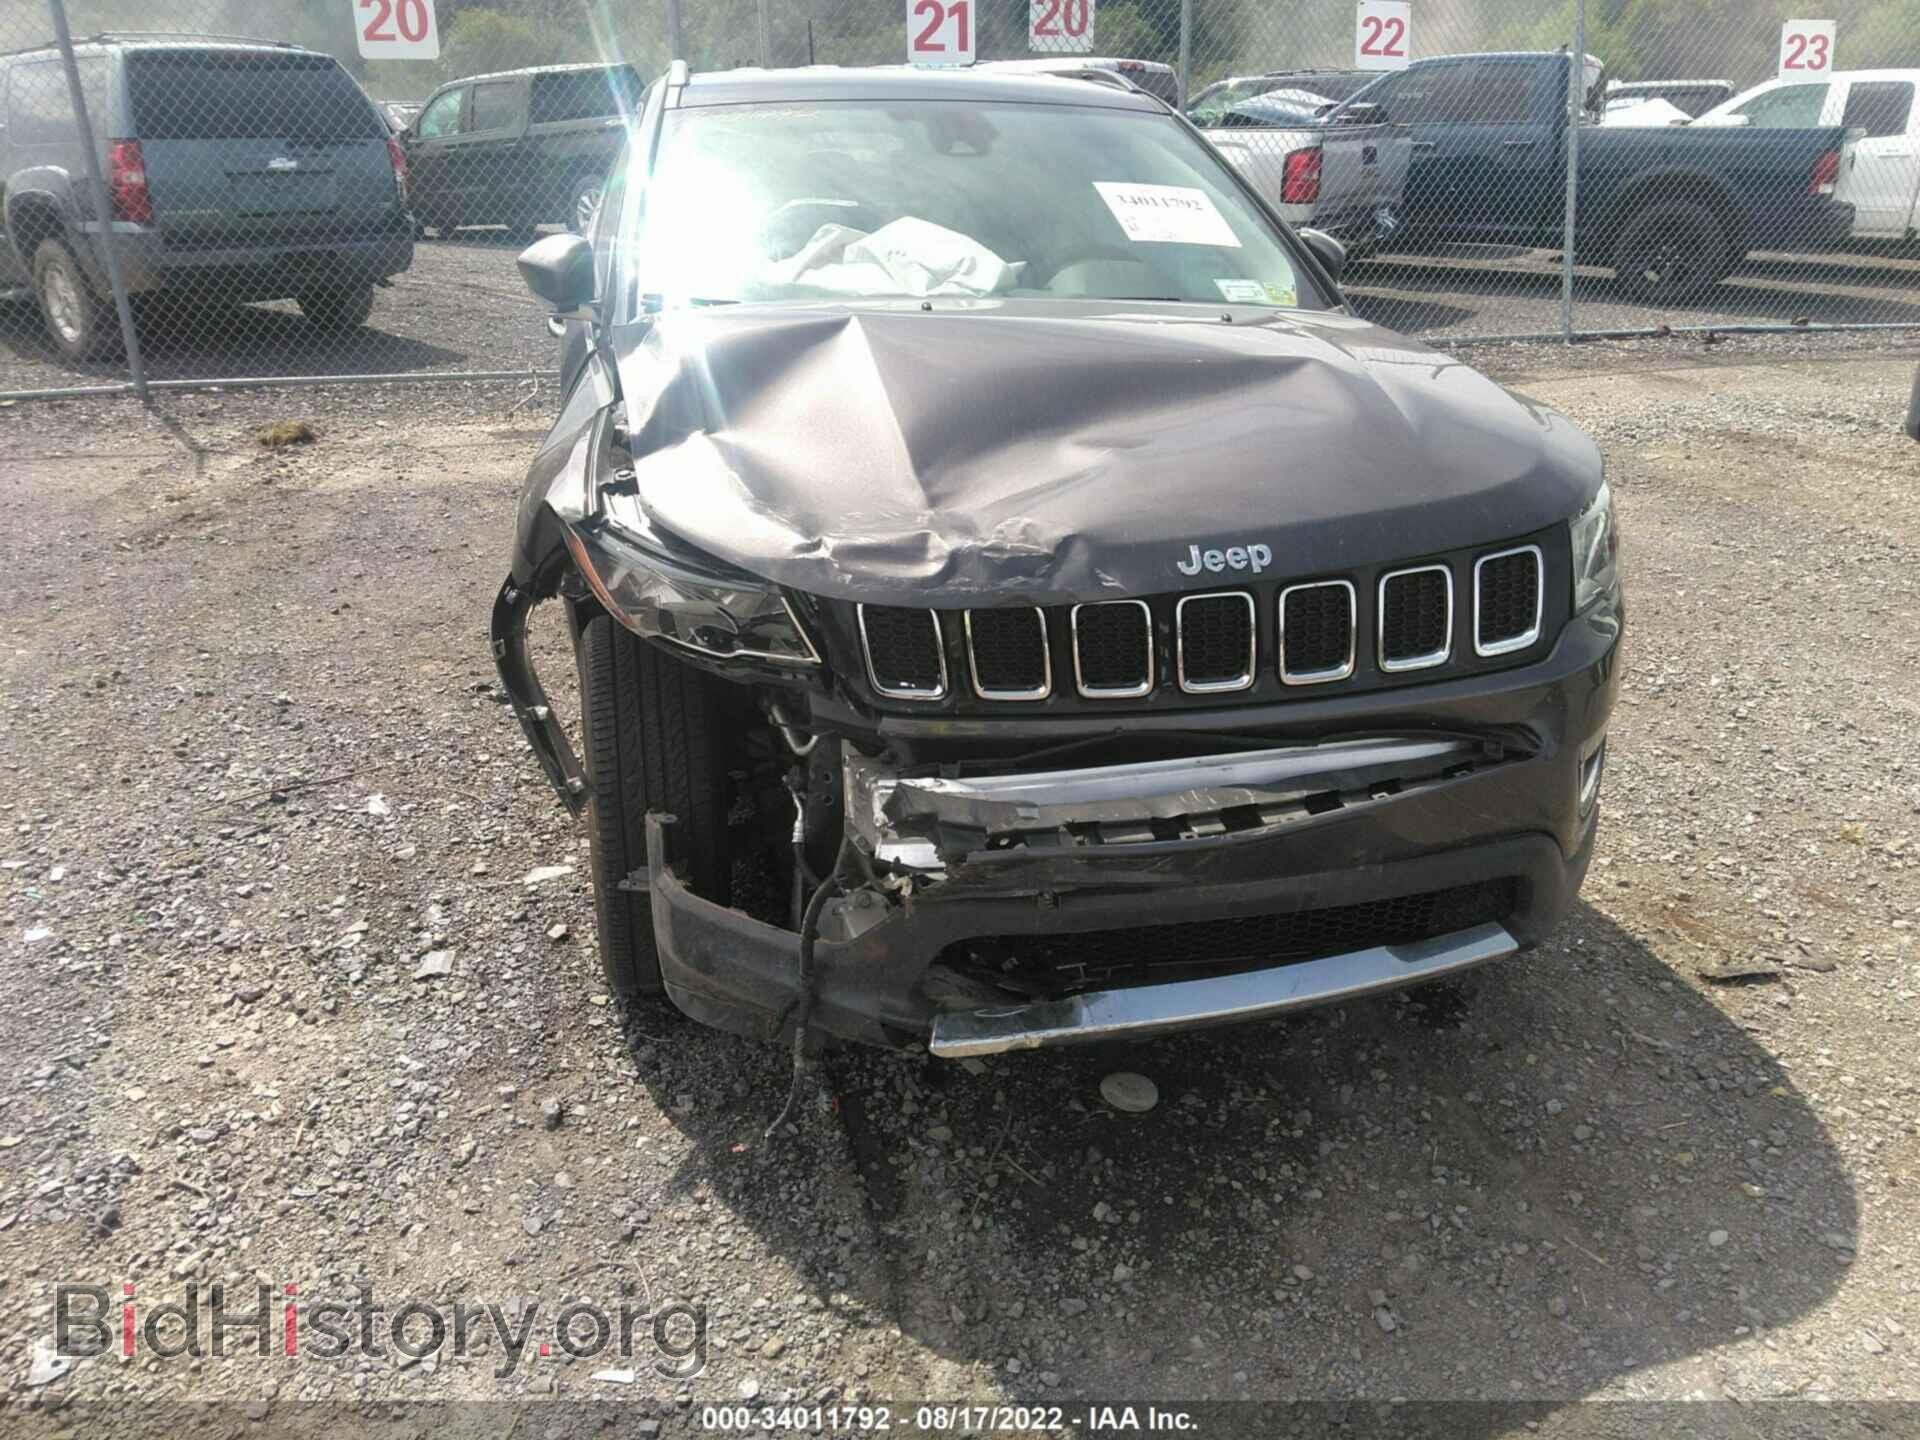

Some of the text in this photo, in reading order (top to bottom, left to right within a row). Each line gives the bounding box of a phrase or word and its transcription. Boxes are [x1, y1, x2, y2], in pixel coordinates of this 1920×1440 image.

[360, 0, 428, 42] 20
[914, 0, 968, 52] 21
[1034, 0, 1089, 37] 20
[1361, 16, 1405, 57] 22
[1784, 34, 1829, 70] 23
[1177, 544, 1272, 575] Jeep
